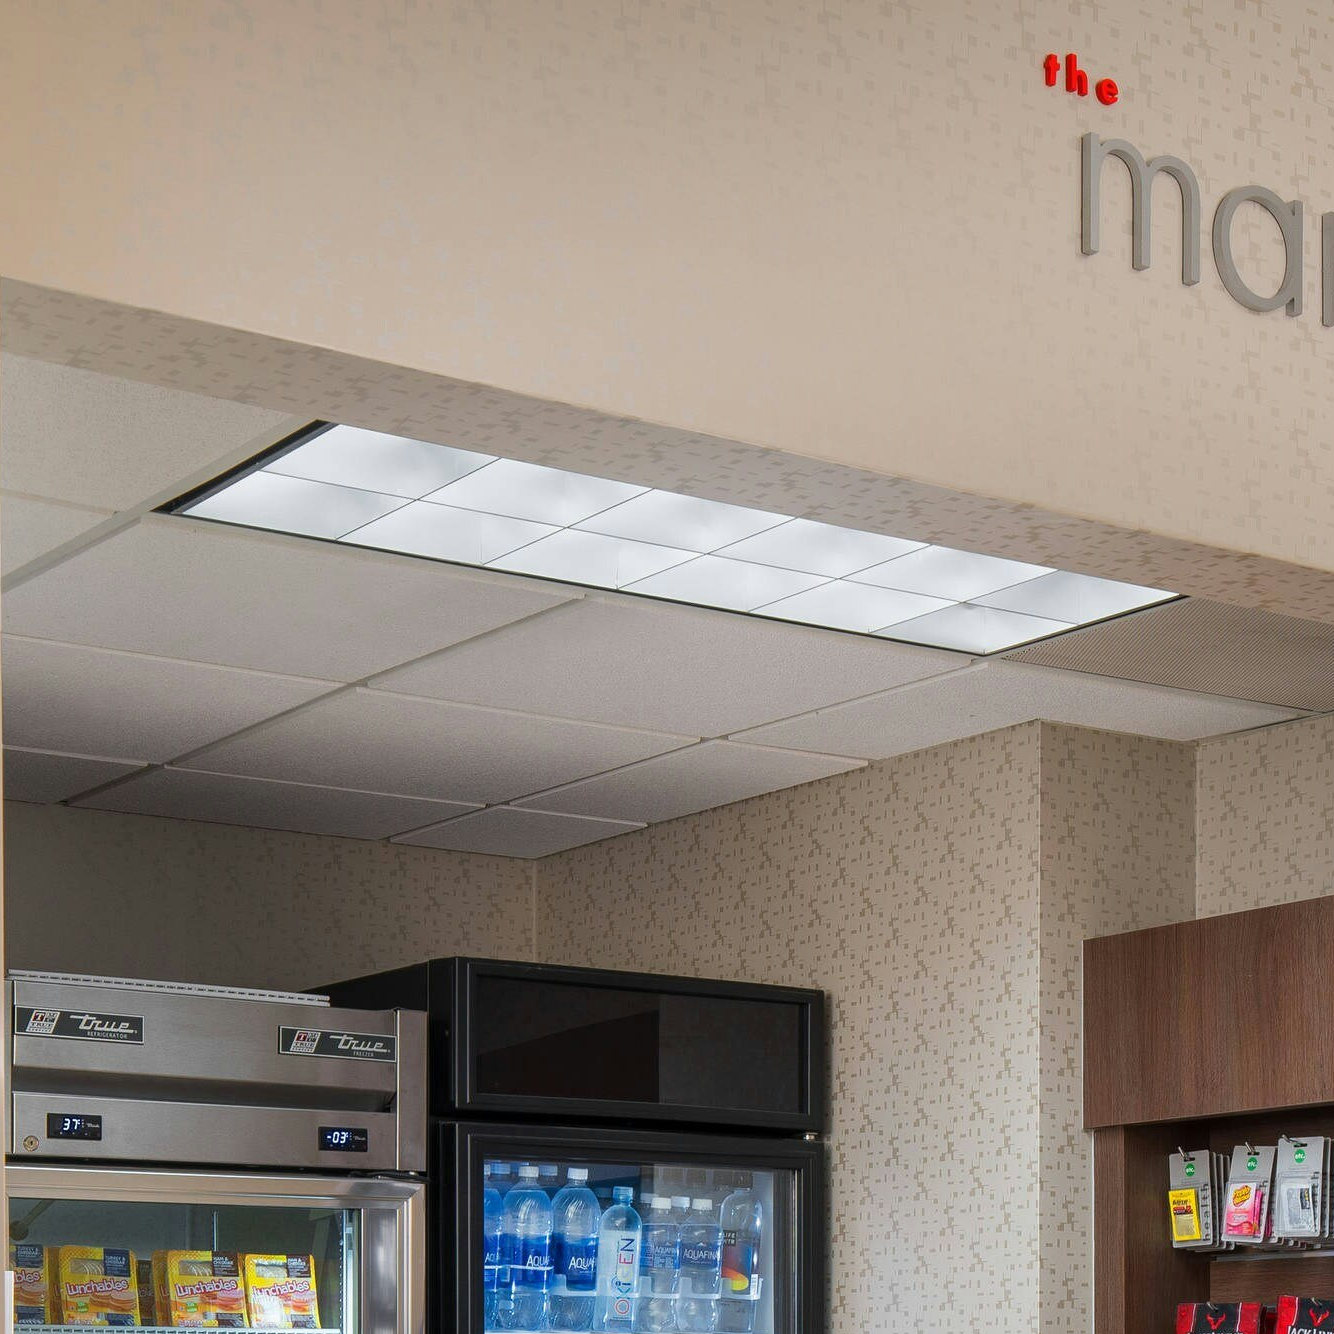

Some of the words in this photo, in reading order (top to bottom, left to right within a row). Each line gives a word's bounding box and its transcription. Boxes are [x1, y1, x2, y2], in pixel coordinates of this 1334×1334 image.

[1043, 53, 1119, 105] the
[87, 1031, 128, 1039] REFRIGERATOR
[1200, 1183, 1211, 1242] health
[67, 1279, 129, 1296] Lunchables
[175, 1279, 238, 1297] Lunchables
[253, 1280, 310, 1297] Lunchables
